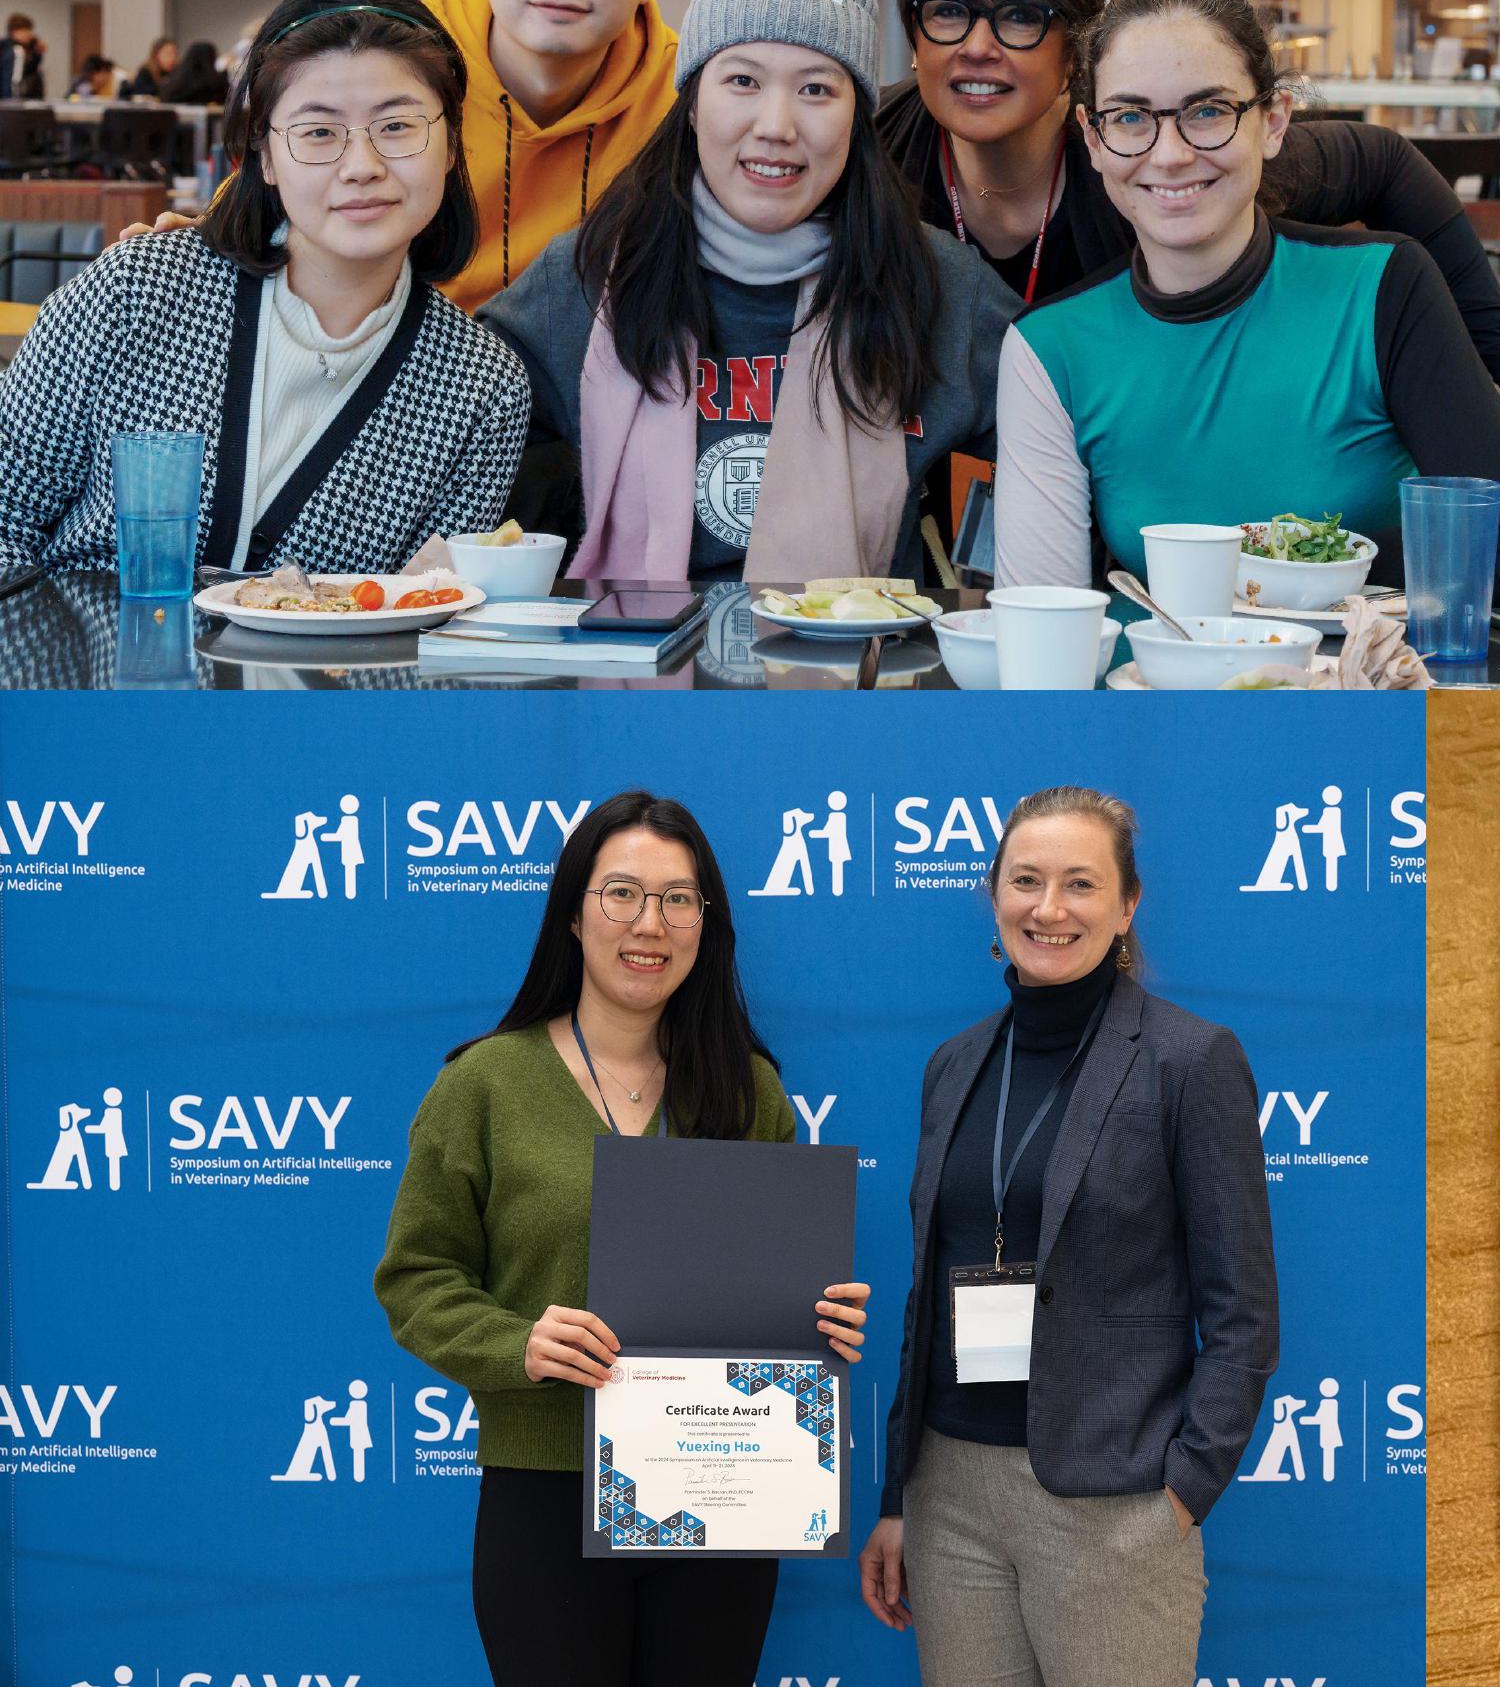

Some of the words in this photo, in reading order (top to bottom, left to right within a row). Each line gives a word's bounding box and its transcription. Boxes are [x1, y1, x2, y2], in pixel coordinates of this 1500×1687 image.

[694, 434, 740, 490] CORNELL
[406, 800, 593, 858] SAVY
[14, 862, 69, 876] Artificial
[72, 862, 146, 878] Intelligence
[407, 863, 479, 878] Symposium
[481, 865, 498, 875] on
[500, 862, 555, 876] Artificial
[895, 859, 967, 874] Symposium
[970, 862, 986, 872] on
[7, 878, 63, 892] Medicine
[895, 876, 907, 889] in
[909, 876, 977, 892] Veterinary
[1390, 871, 1402, 884] in
[407, 877, 419, 891] in
[421, 877, 488, 894] Veterinary
[491, 878, 549, 892] Medicine
[169, 1094, 352, 1150] SAVY
[170, 1156, 241, 1171] Symposium
[243, 1159, 260, 1169] on
[262, 1156, 316, 1169] Artificial
[319, 1157, 392, 1172] Intelligence
[1294, 1152, 1369, 1168] Intelligence
[171, 1172, 182, 1184] in
[185, 1172, 251, 1187] Veterinary
[253, 1173, 310, 1185] Medicine
[666, 1405, 729, 1416] Certificate
[733, 1405, 770, 1416] Award
[11, 1447, 27, 1457] on
[29, 1444, 83, 1458] Artificial
[85, 1445, 157, 1460] Intelligence
[677, 1441, 731, 1454] Yuexing
[735, 1441, 761, 1452] Hao
[21, 1461, 76, 1474] Medicine
[415, 1464, 427, 1476] in
[1386, 1463, 1398, 1474] in
[804, 1533, 829, 1542] SAVY
